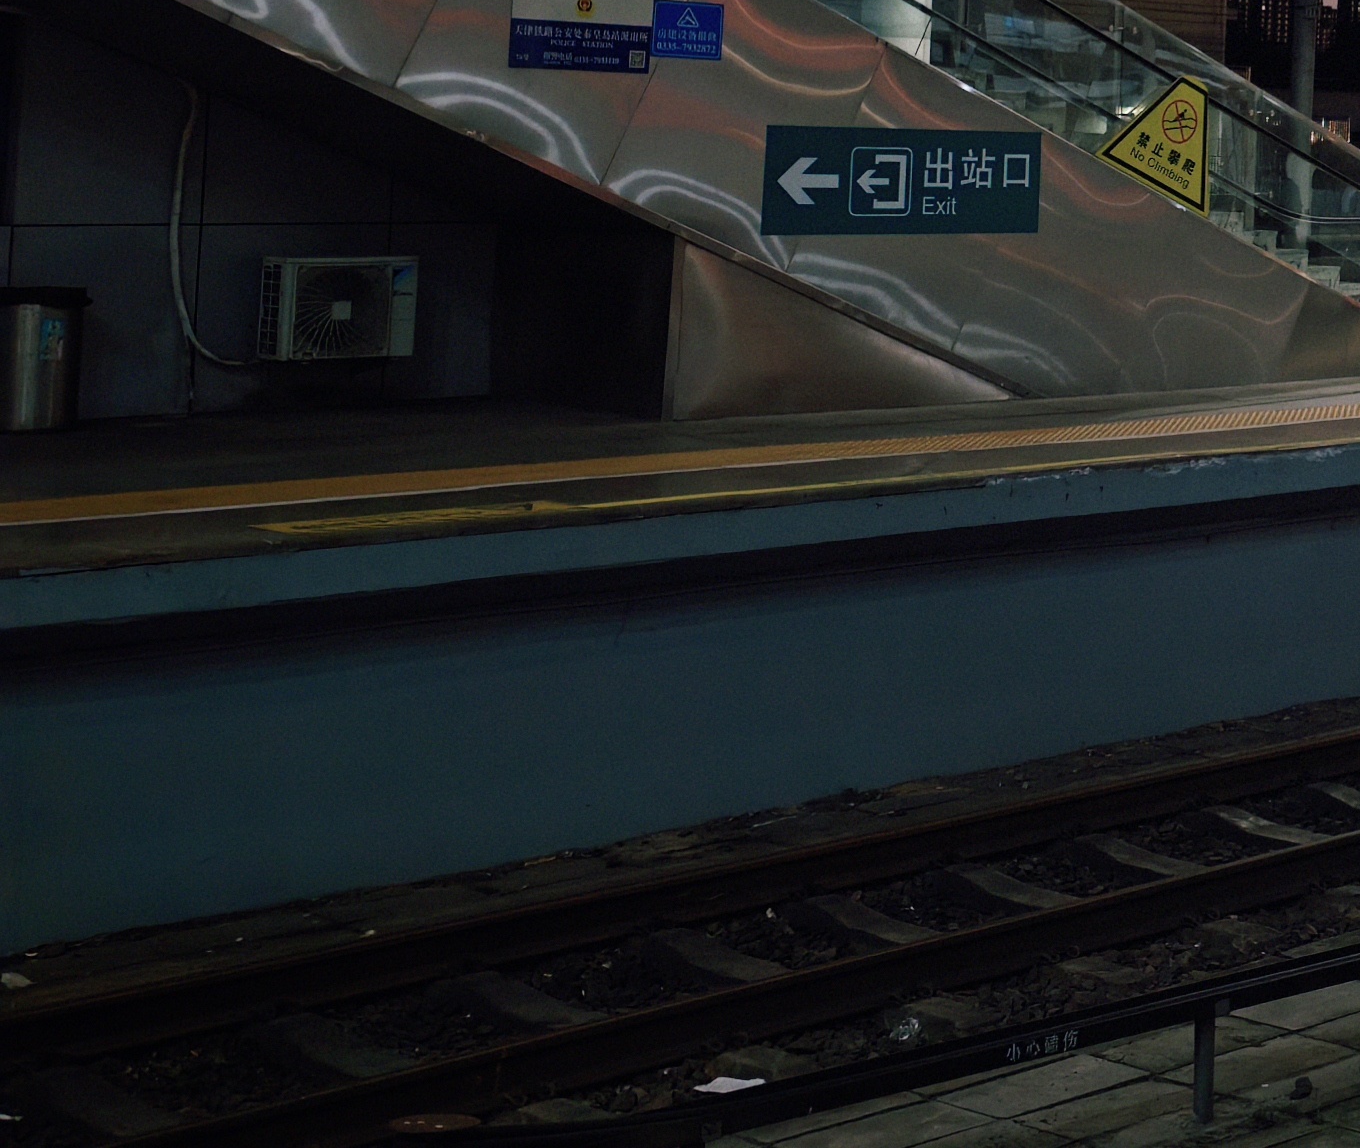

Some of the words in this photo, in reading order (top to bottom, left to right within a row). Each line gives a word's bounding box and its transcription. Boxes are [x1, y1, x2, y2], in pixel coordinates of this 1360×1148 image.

[922, 148, 1031, 191] 出站口
[1130, 147, 1145, 162] No
[1147, 157, 1190, 190] Climbing
[1136, 132, 1197, 175] 禁止攀爬
[922, 197, 956, 216] Exit
